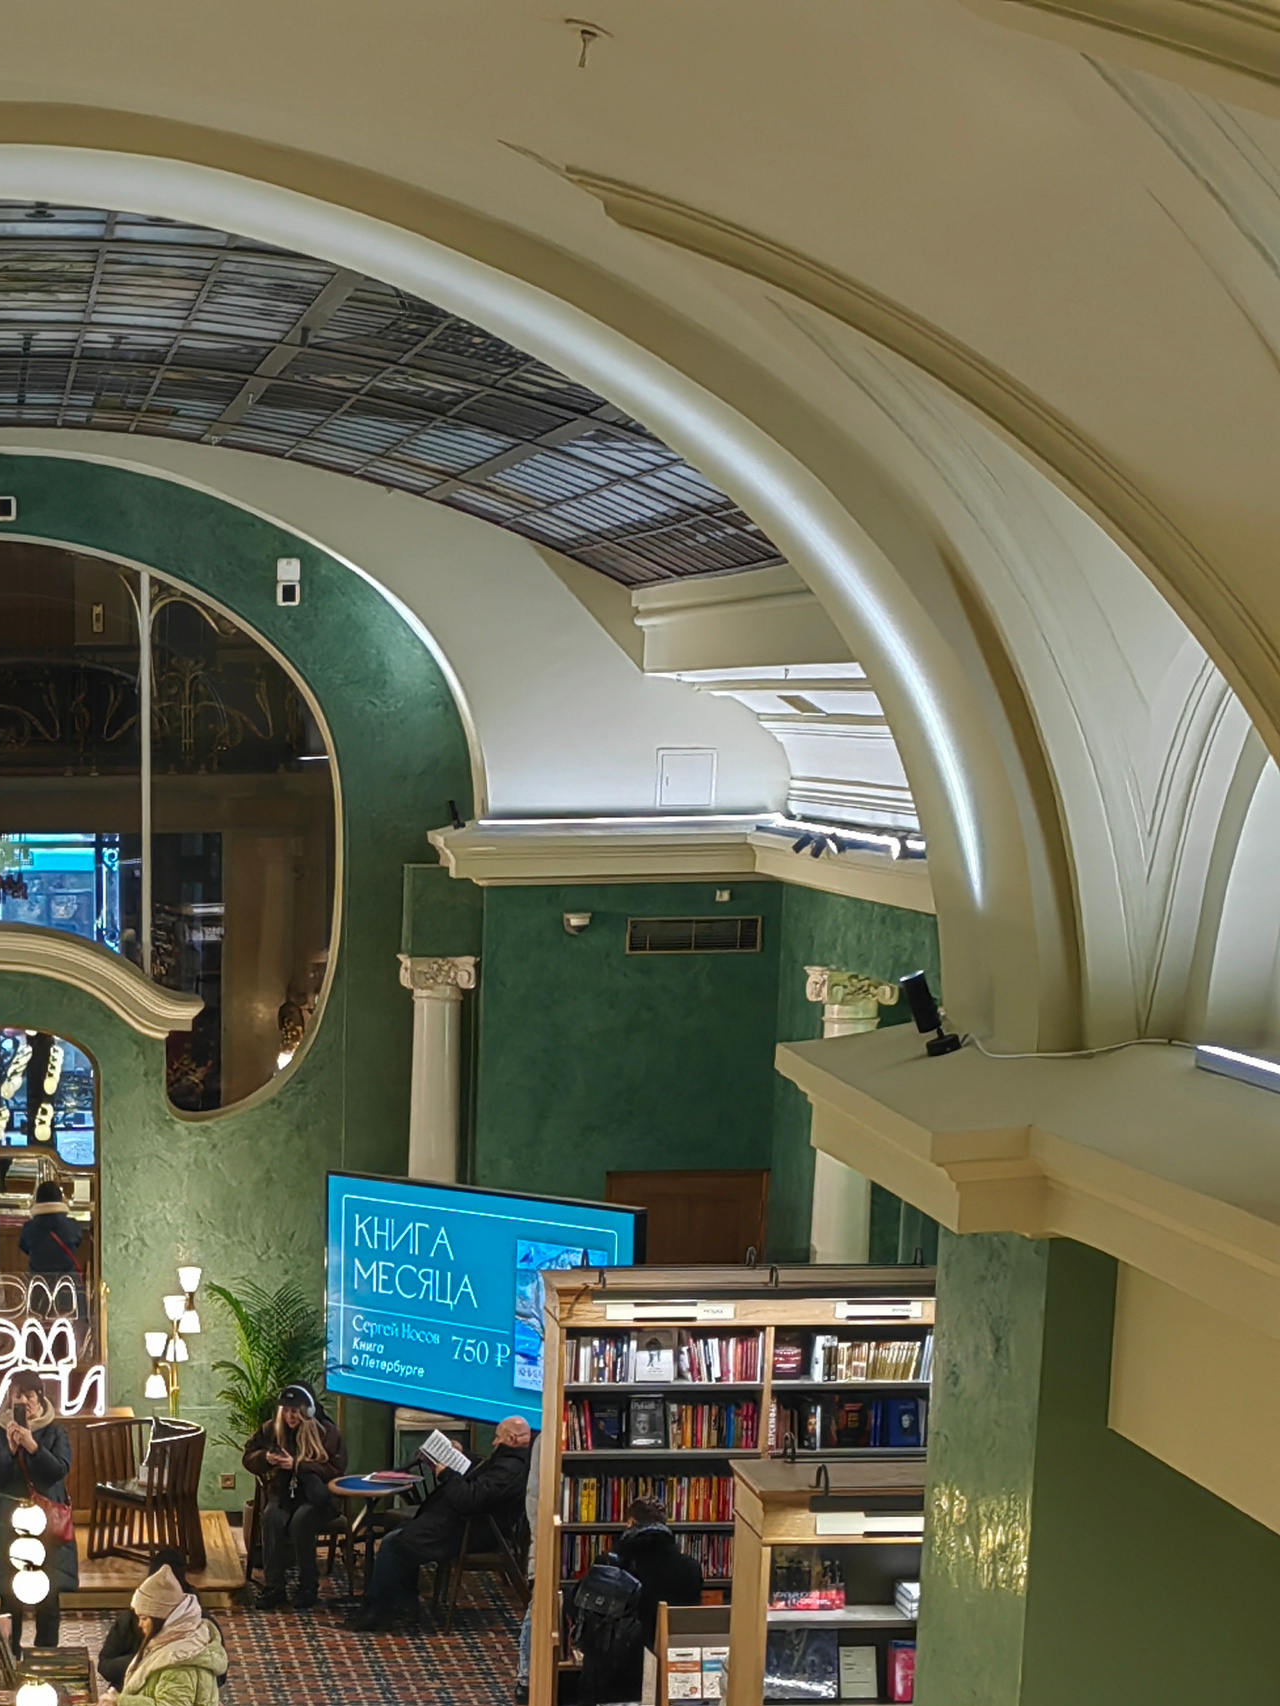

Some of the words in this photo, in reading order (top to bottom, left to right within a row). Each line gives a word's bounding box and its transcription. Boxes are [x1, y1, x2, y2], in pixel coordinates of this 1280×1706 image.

[354, 1213, 454, 1261] КНИГА
[353, 1258, 478, 1310] МЕСЯЦА
[352, 1314, 399, 1337] Сергей
[402, 1323, 440, 1344] Носов
[352, 1337, 384, 1354] Книга
[451, 1335, 489, 1365] 750
[361, 1354, 425, 1377] Петербурге
